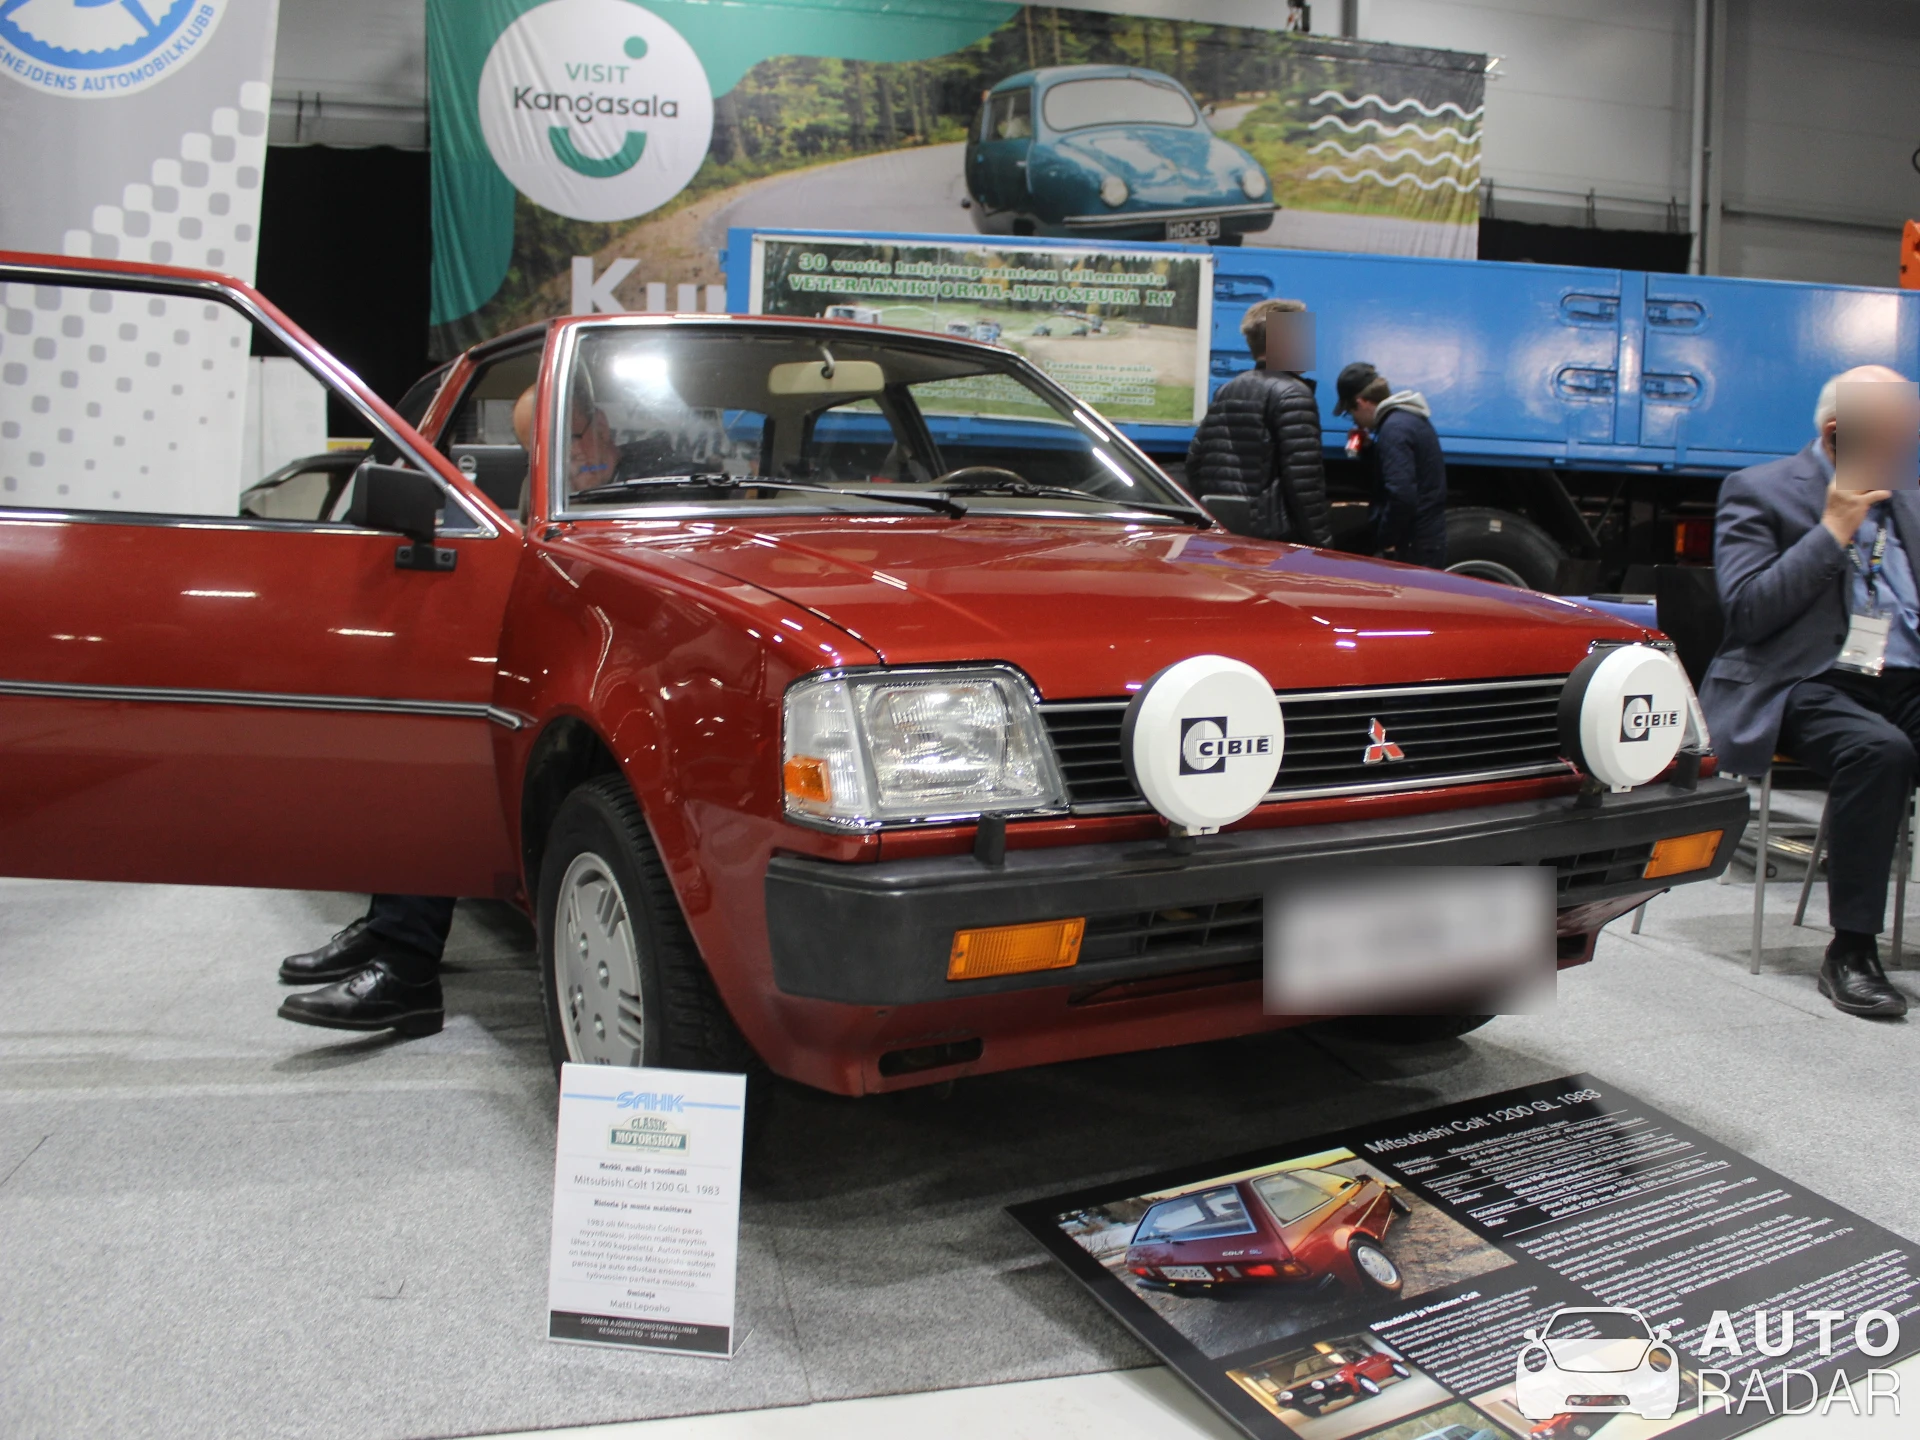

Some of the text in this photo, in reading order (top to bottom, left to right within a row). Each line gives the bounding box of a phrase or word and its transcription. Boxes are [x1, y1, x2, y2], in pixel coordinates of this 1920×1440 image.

[82, 4, 215, 92] AUTOMOBILKLUBB
[565, 62, 630, 84] VISIT
[513, 87, 678, 124] Kangasala
[799, 253, 1167, 286] 30 vuotta kuljetusperinteen tallennusta
[788, 274, 1176, 307] VETERAANIKUORMA-AUTOSEURA RY
[616, 1091, 685, 1113] SAHK
[631, 1116, 668, 1132] CLASSIC
[1364, 1088, 1602, 1154] Mitsubishi Colt 1200 GL 1983
[615, 1131, 682, 1148] MOTORSHOW
[574, 1175, 720, 1196] Mitsubishi Colt 1200 GL 1983
[610, 1299, 632, 1309] Matti
